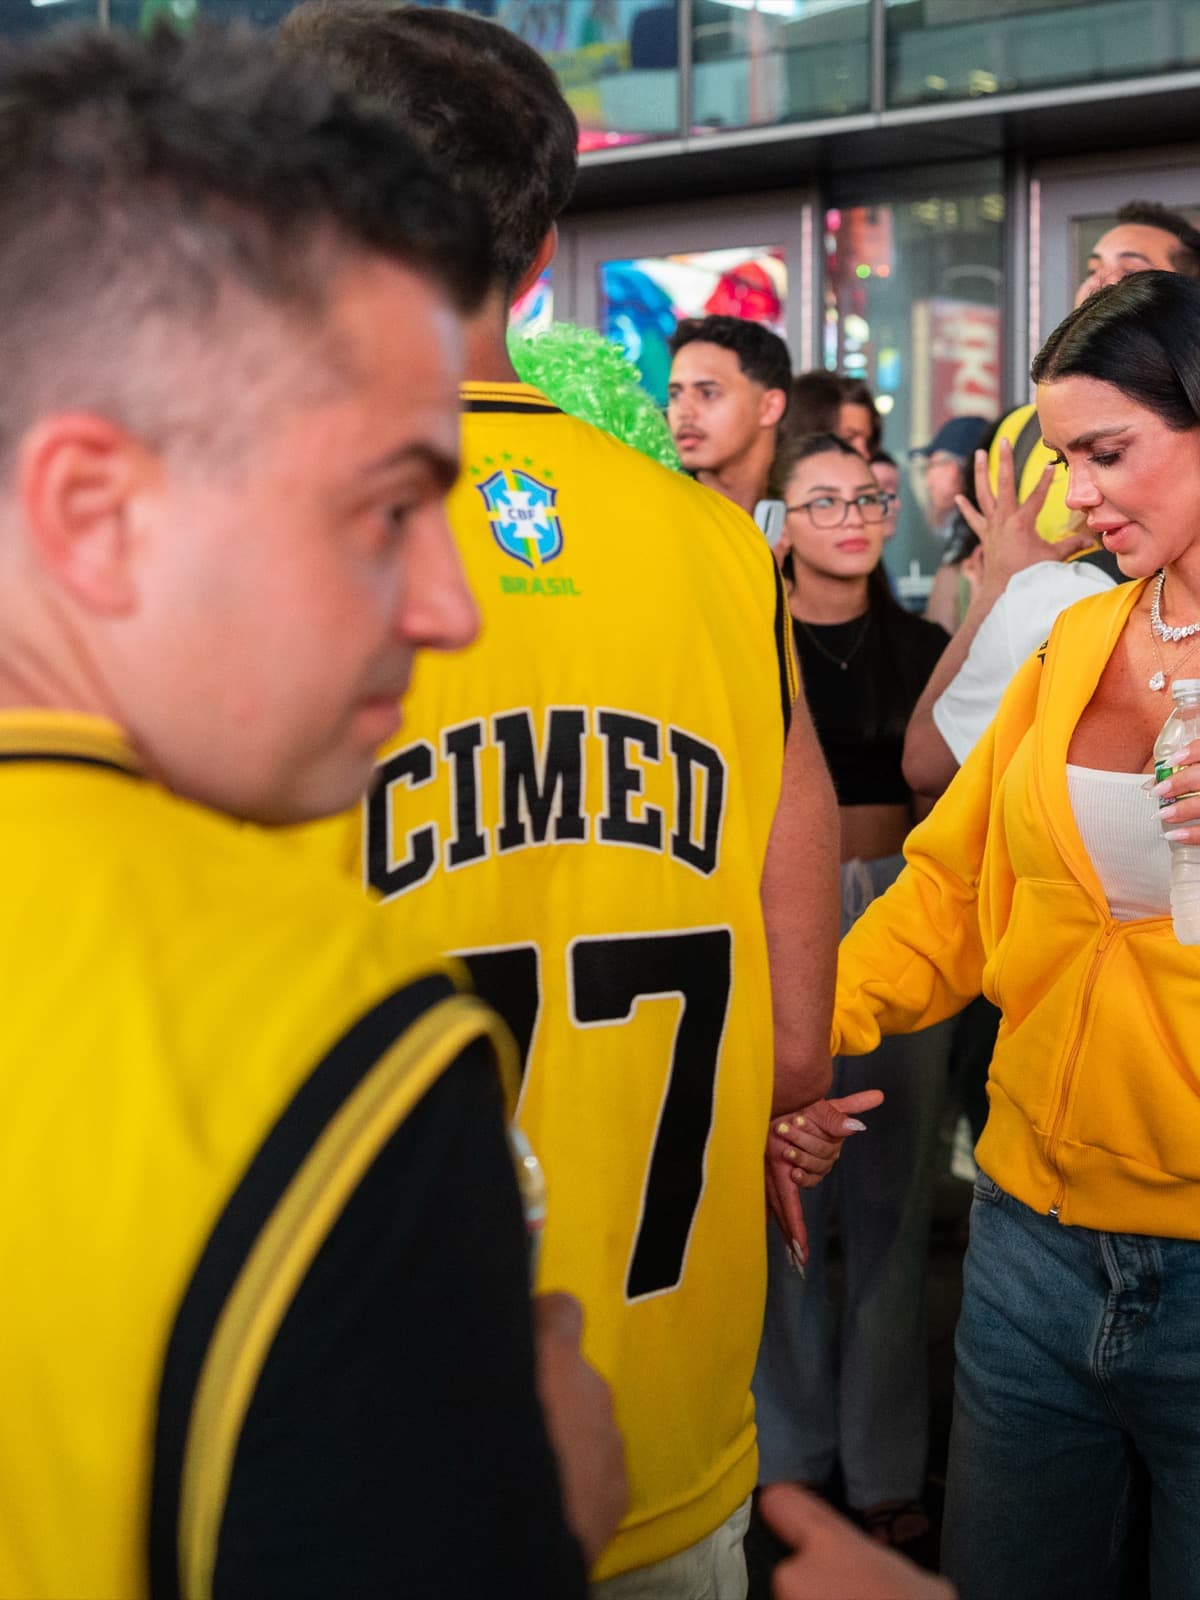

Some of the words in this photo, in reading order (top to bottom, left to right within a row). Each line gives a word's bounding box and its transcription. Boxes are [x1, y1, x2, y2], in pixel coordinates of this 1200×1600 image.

[507, 508, 536, 521] CBF
[499, 575, 582, 595] BRASIL
[363, 705, 728, 905] CIMED
